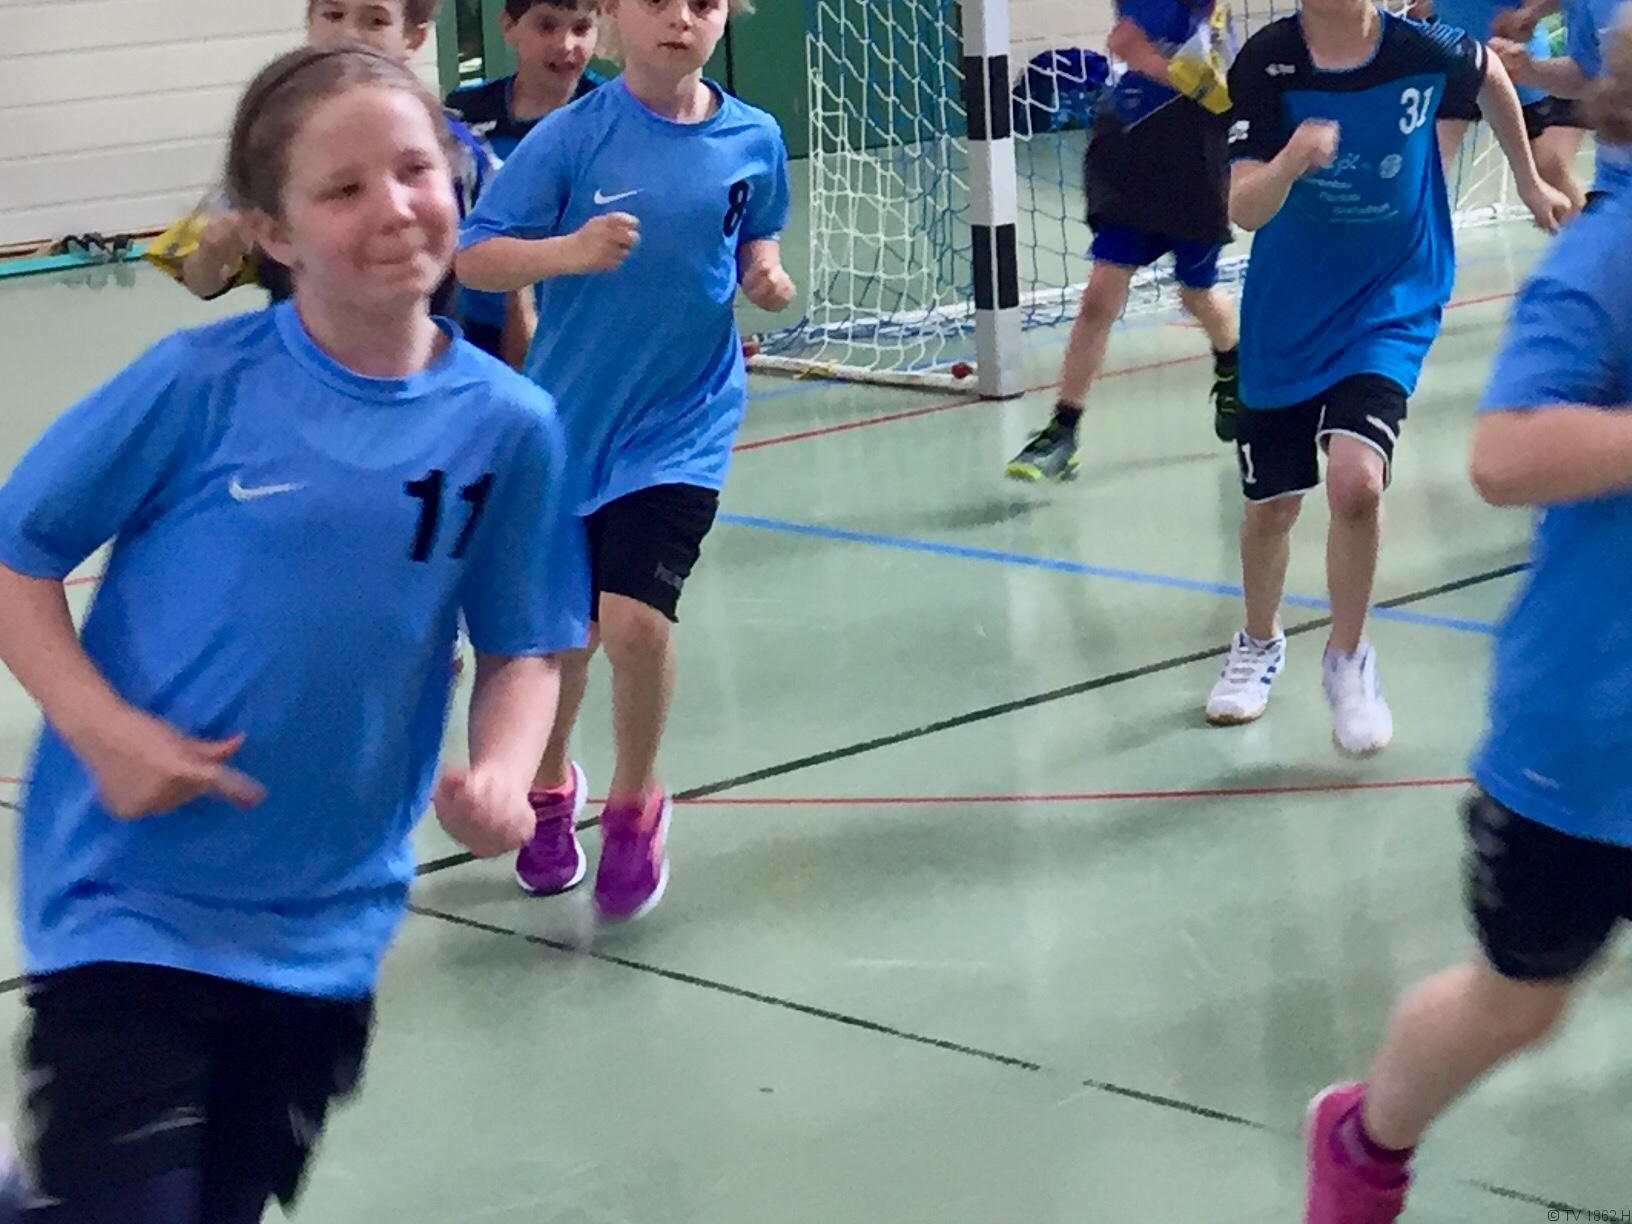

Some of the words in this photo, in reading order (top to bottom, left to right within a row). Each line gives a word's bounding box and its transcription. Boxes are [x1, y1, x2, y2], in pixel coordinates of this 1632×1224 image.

[1399, 85, 1434, 135] 31
[722, 179, 750, 238] 8
[402, 468, 496, 563] 11
